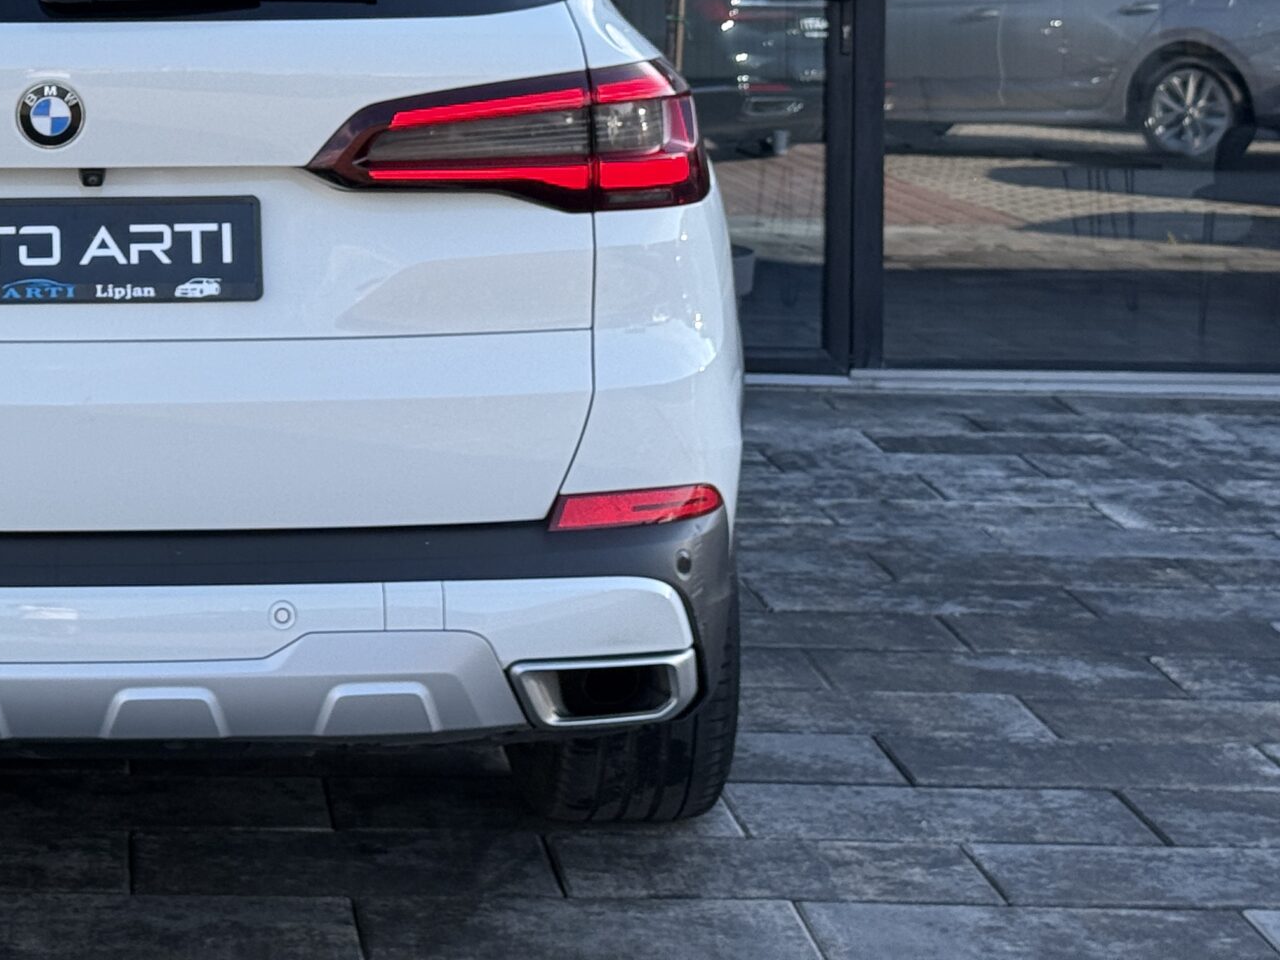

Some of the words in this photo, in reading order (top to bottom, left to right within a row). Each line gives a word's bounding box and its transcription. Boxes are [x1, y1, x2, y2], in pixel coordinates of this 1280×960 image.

[24, 85, 79, 107] BMW
[79, 222, 233, 266] ARTI
[2, 287, 76, 299] ARTI
[95, 284, 156, 300] Lipjan
